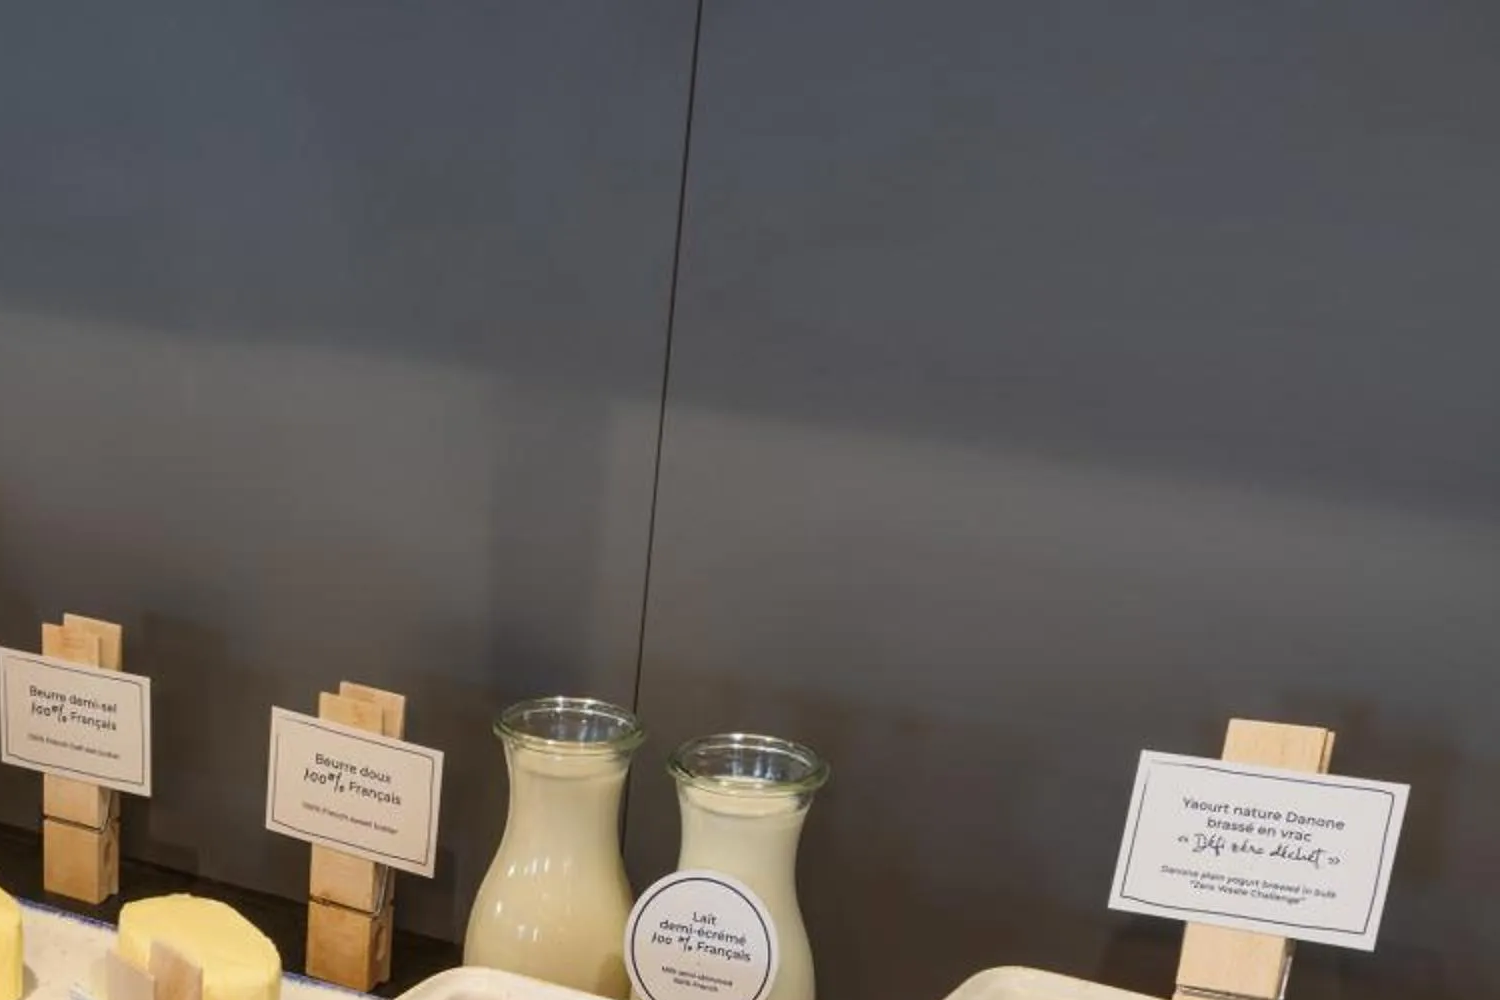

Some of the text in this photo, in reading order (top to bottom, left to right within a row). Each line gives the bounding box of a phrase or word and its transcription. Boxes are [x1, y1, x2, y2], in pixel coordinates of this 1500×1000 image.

[29, 685, 117, 713] Beurre demi-sel
[70, 711, 117, 731] Français
[315, 753, 391, 783] Beurre doux
[349, 781, 401, 805] Français
[1182, 797, 1345, 830] Yaourt nature Danone
[1207, 817, 1312, 843] brassé en vrac
[692, 911, 717, 926] Lait
[659, 919, 747, 946] demi-écrémé
[697, 941, 751, 962] Français
